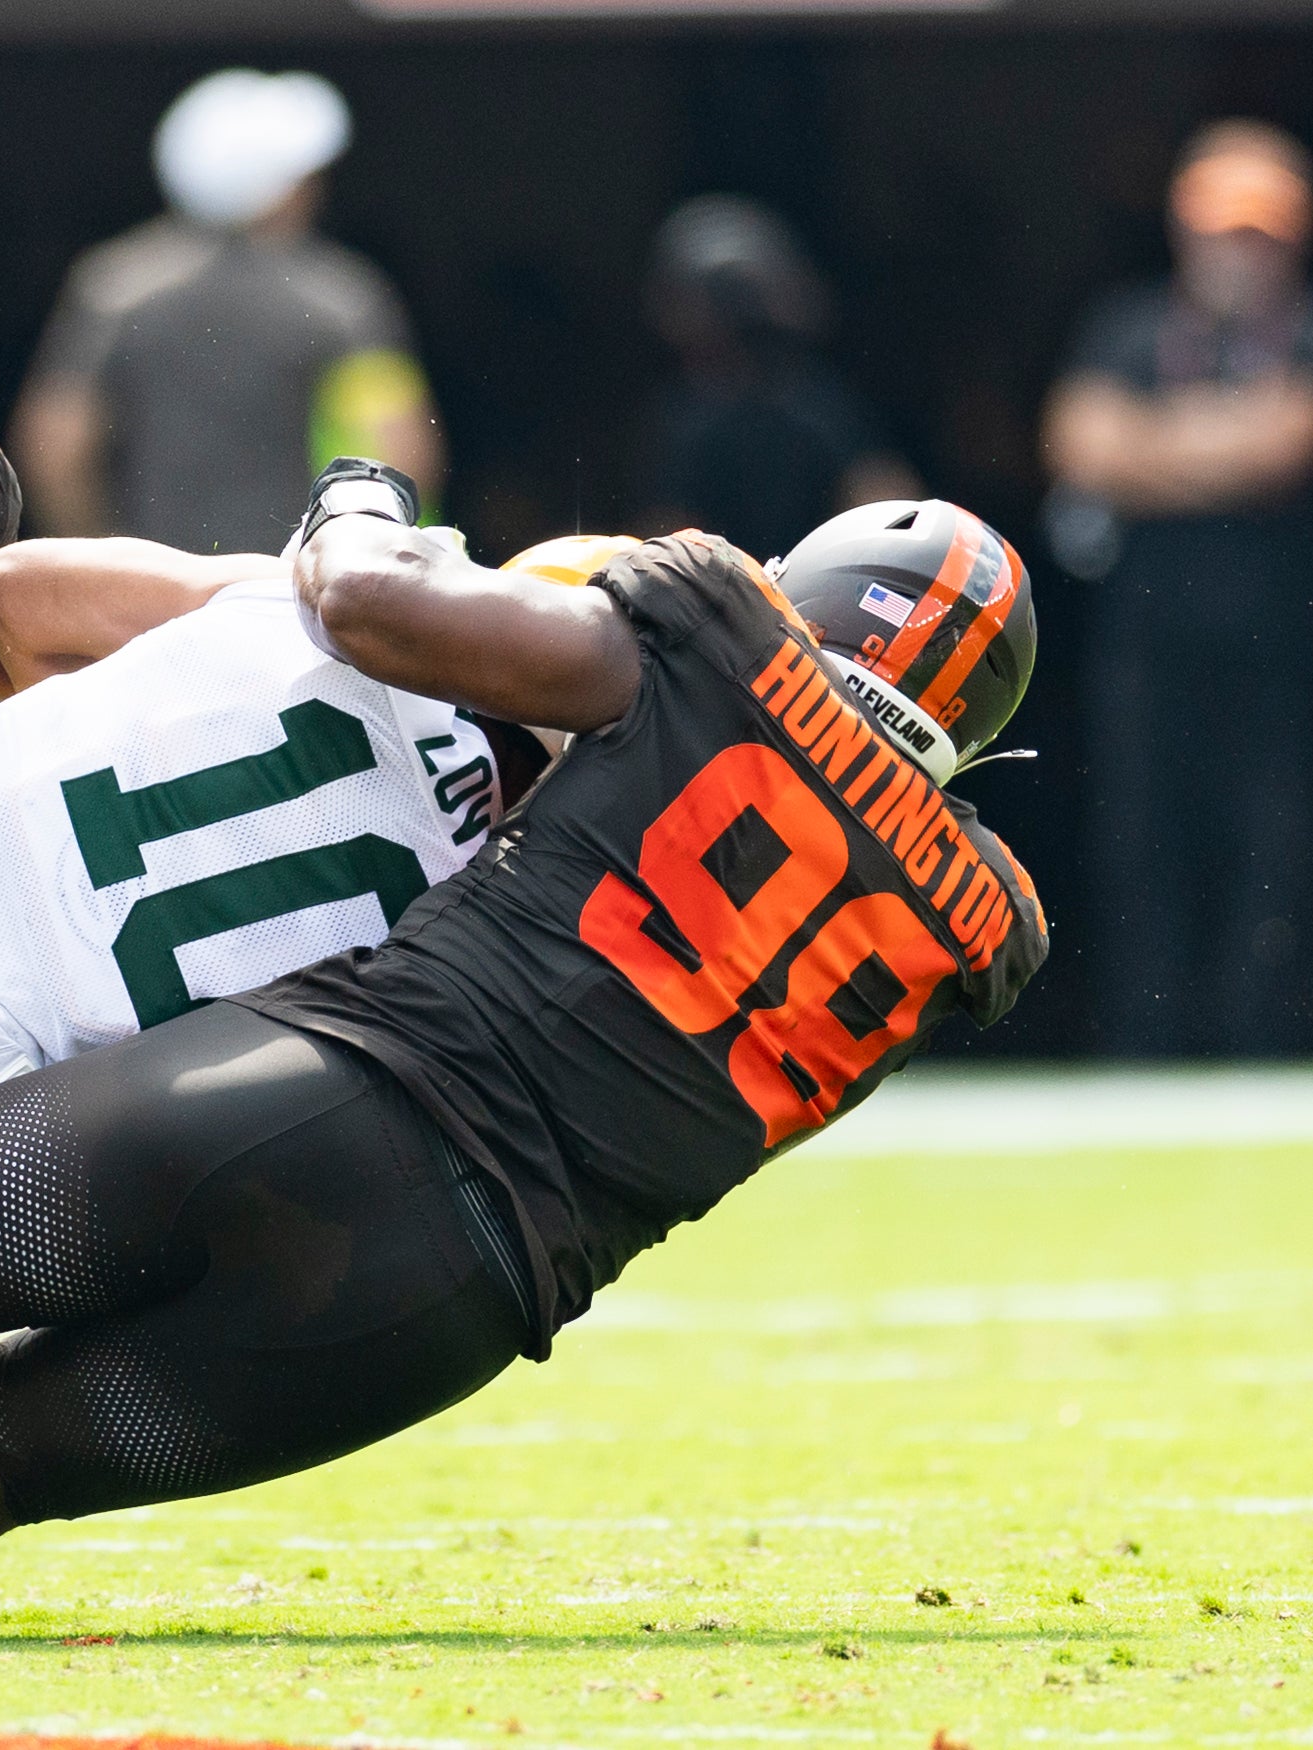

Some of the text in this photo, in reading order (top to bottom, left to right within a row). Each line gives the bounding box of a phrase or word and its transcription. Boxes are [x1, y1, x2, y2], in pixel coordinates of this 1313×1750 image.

[60, 699, 431, 1032] 10
[750, 636, 1014, 972] HUNTINGTON
[845, 673, 936, 754] CLEVELAND
[578, 742, 958, 1148] 98
